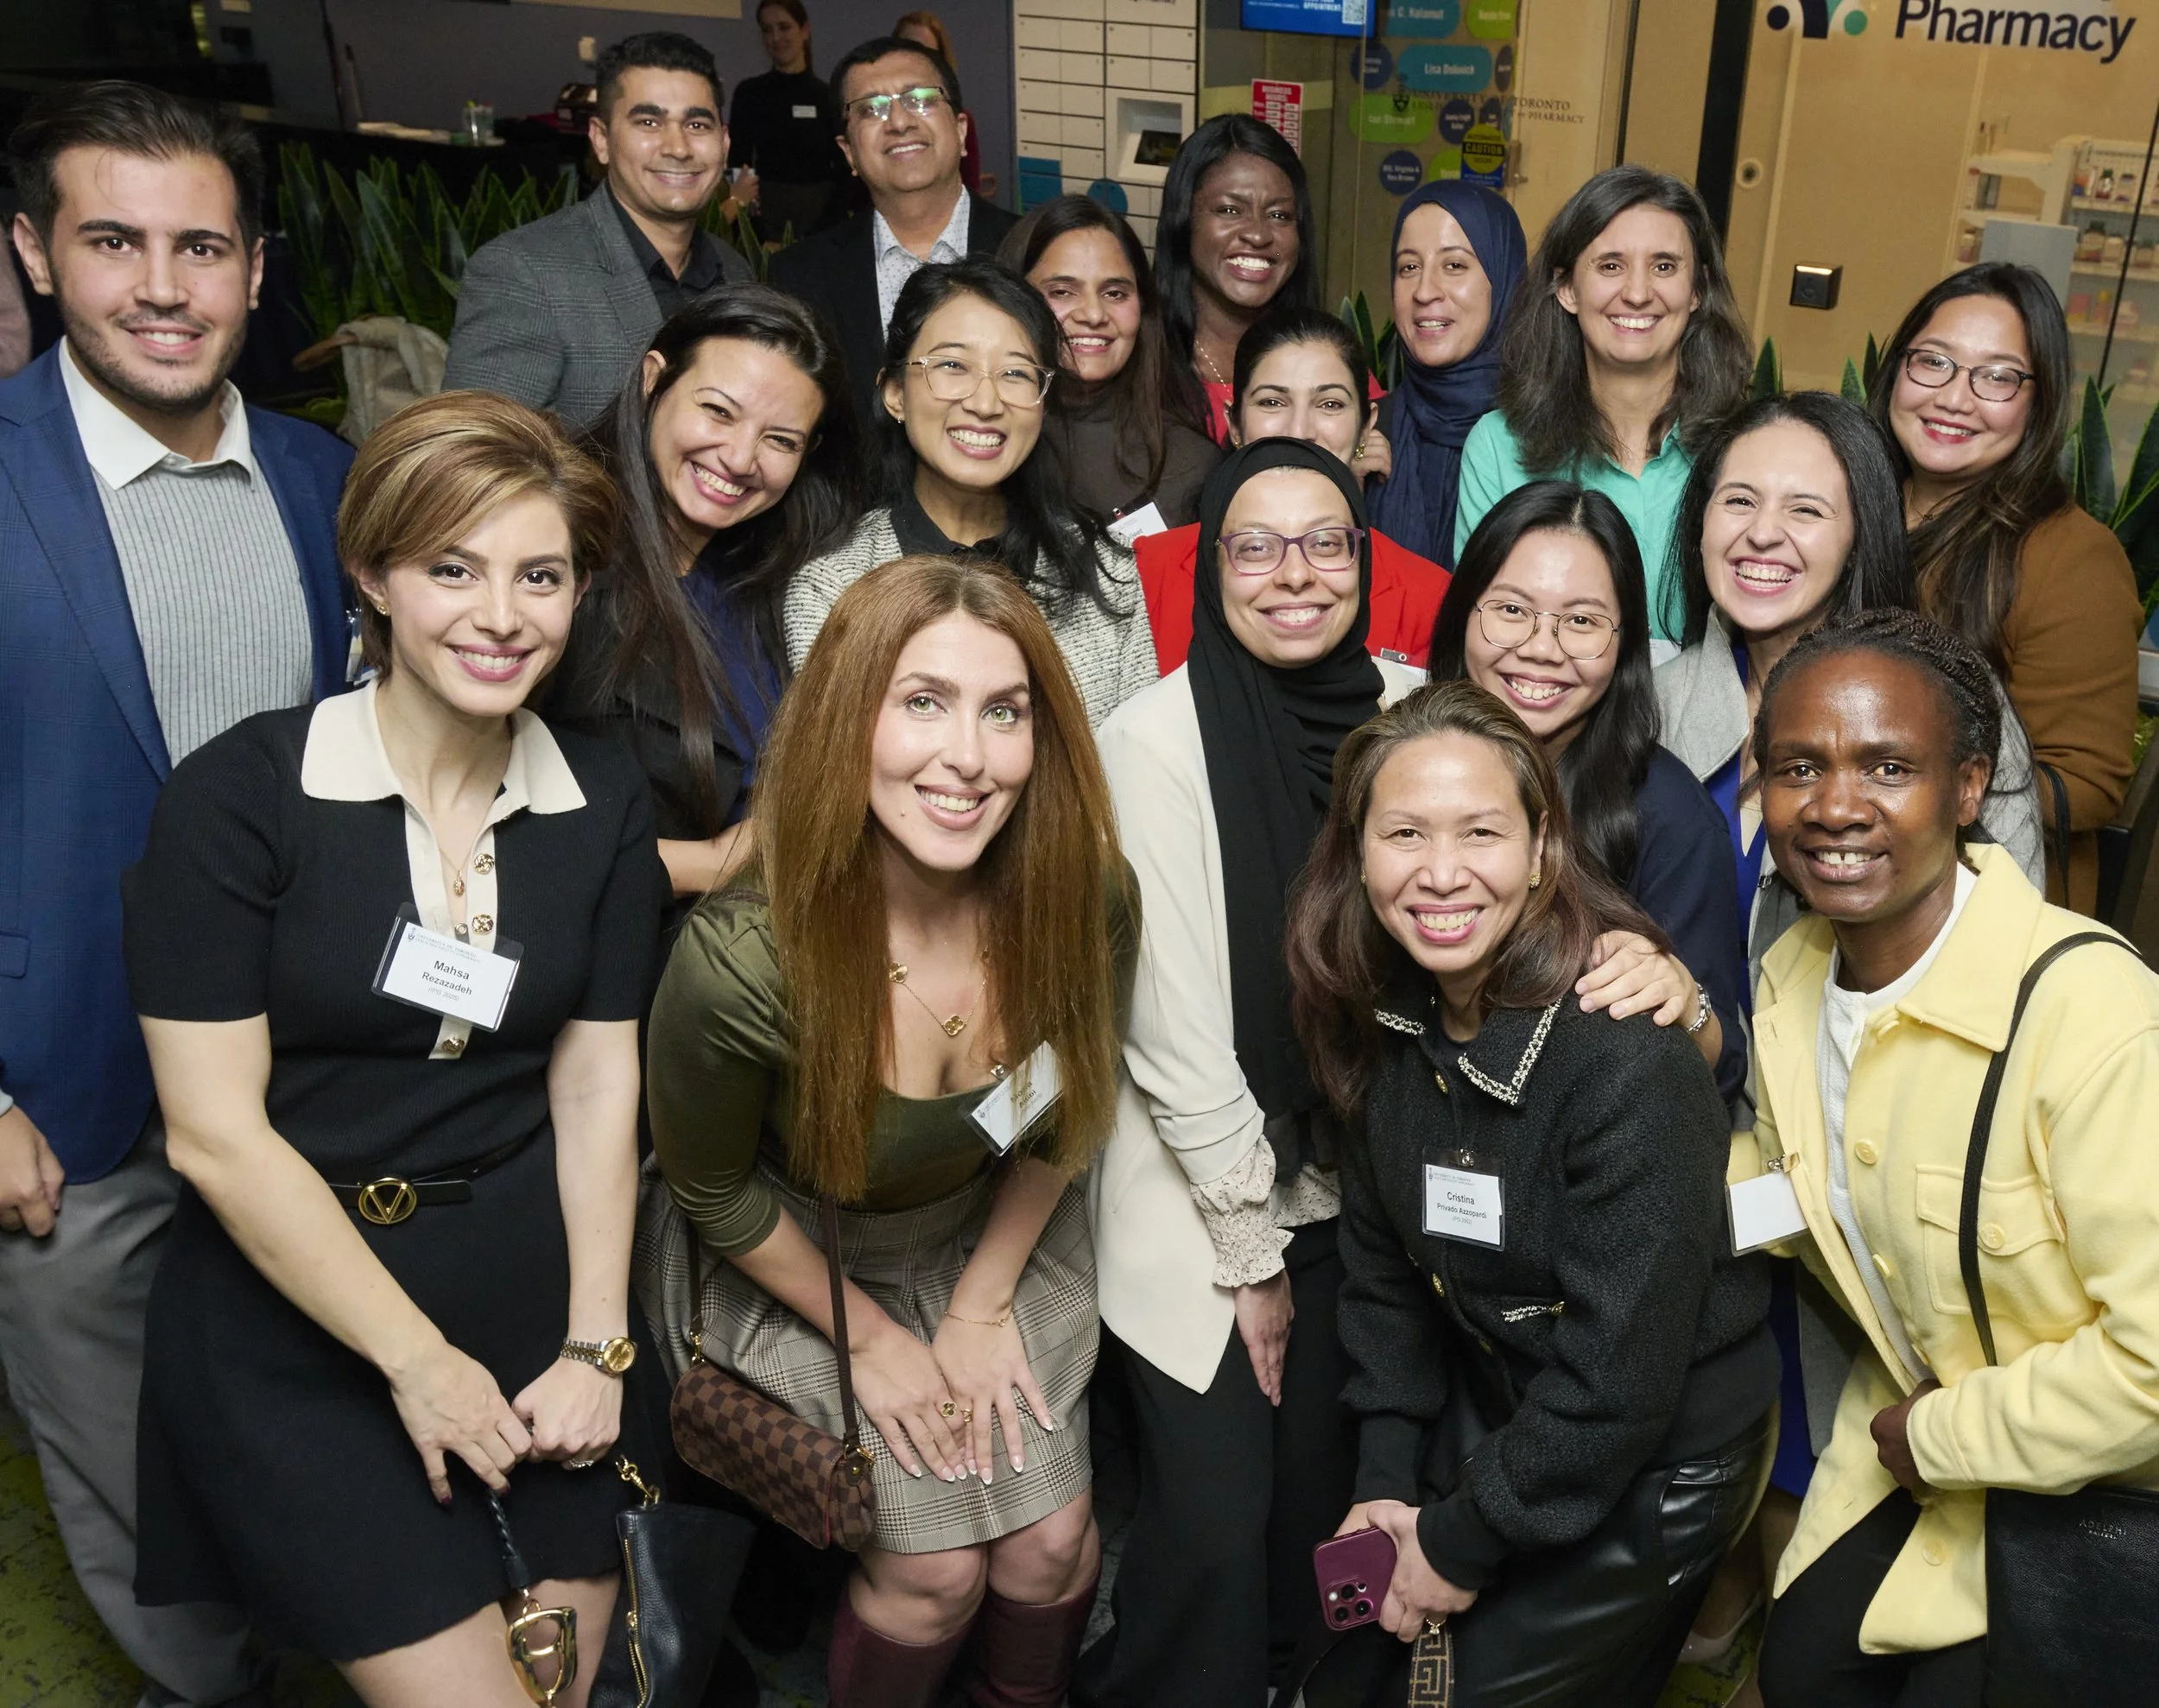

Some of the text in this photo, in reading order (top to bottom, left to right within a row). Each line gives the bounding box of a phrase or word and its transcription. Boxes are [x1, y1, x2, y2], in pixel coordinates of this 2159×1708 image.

[1896, 0, 2137, 64] Pharmacy
[1514, 97, 1570, 111] TORONTO
[1528, 111, 1585, 123] PHARMACY
[1466, 142, 1503, 155] CAUTION
[434, 960, 470, 981] Mahsa
[421, 971, 472, 996] Rezazadeh
[1447, 1192, 1475, 1205] Cristina
[1437, 1203, 1487, 1219] Privado Azzopardi
